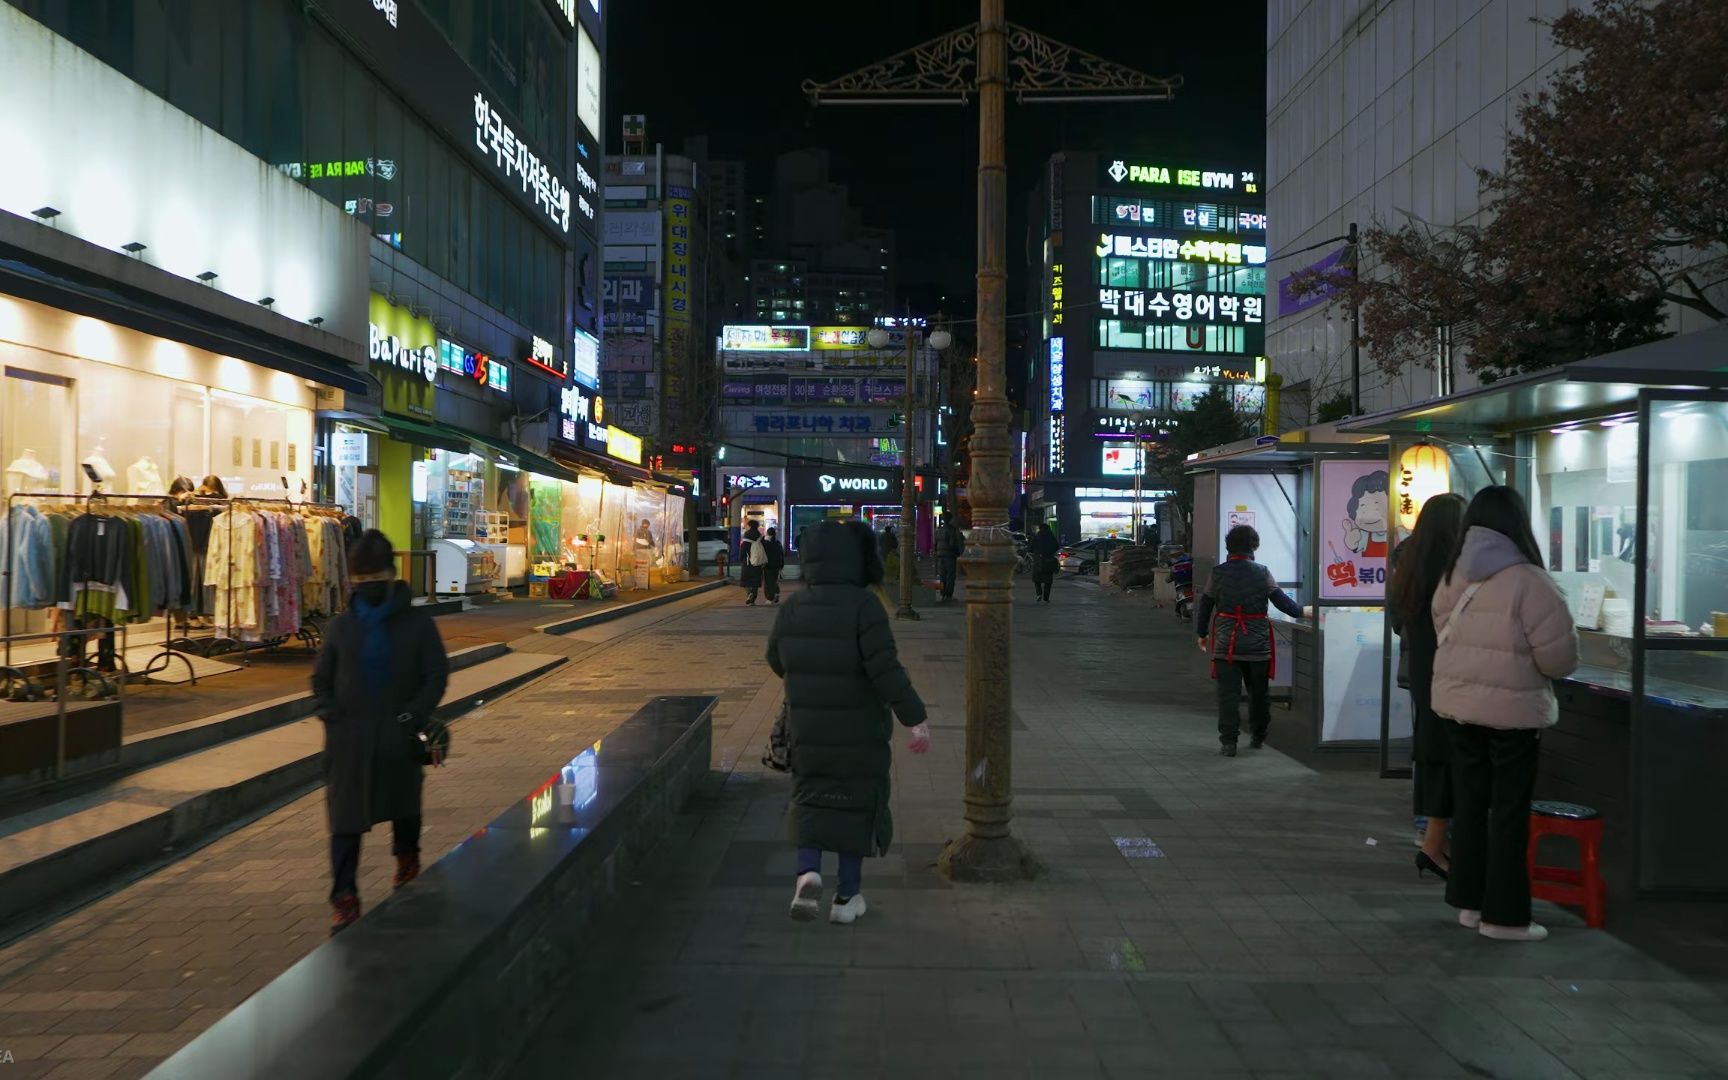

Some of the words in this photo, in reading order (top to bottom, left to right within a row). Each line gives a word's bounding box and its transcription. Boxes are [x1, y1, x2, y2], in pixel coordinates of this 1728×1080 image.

[474, 92, 571, 233] 한국투자저축은행
[1201, 171, 1234, 189] GYM
[1238, 212, 1267, 230] 국어
[1099, 288, 1263, 323] 박대수영어학원
[839, 478, 888, 491] WORLD
